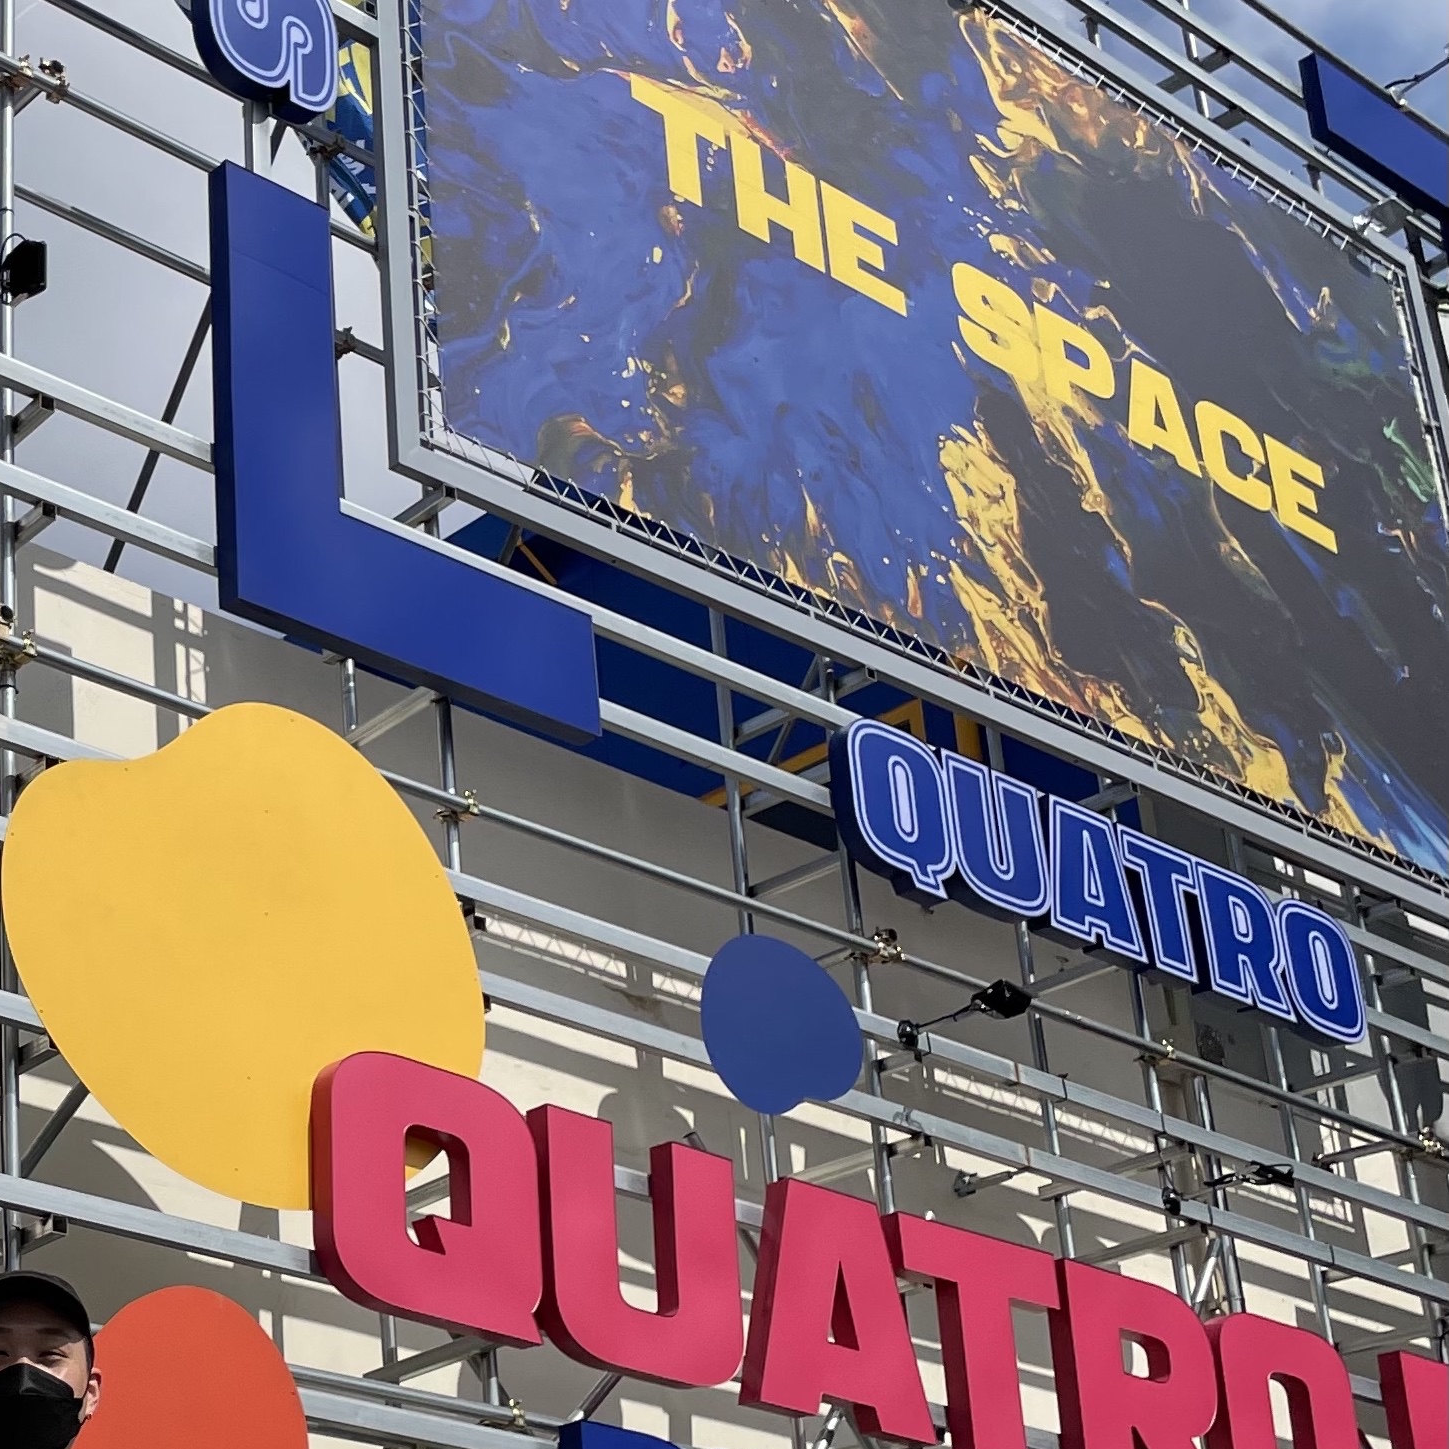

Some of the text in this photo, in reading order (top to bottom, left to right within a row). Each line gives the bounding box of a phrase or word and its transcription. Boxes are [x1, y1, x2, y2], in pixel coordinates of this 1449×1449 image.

[630, 72, 1337, 554] THE SPACE
[834, 717, 1368, 1045] QUATRO
